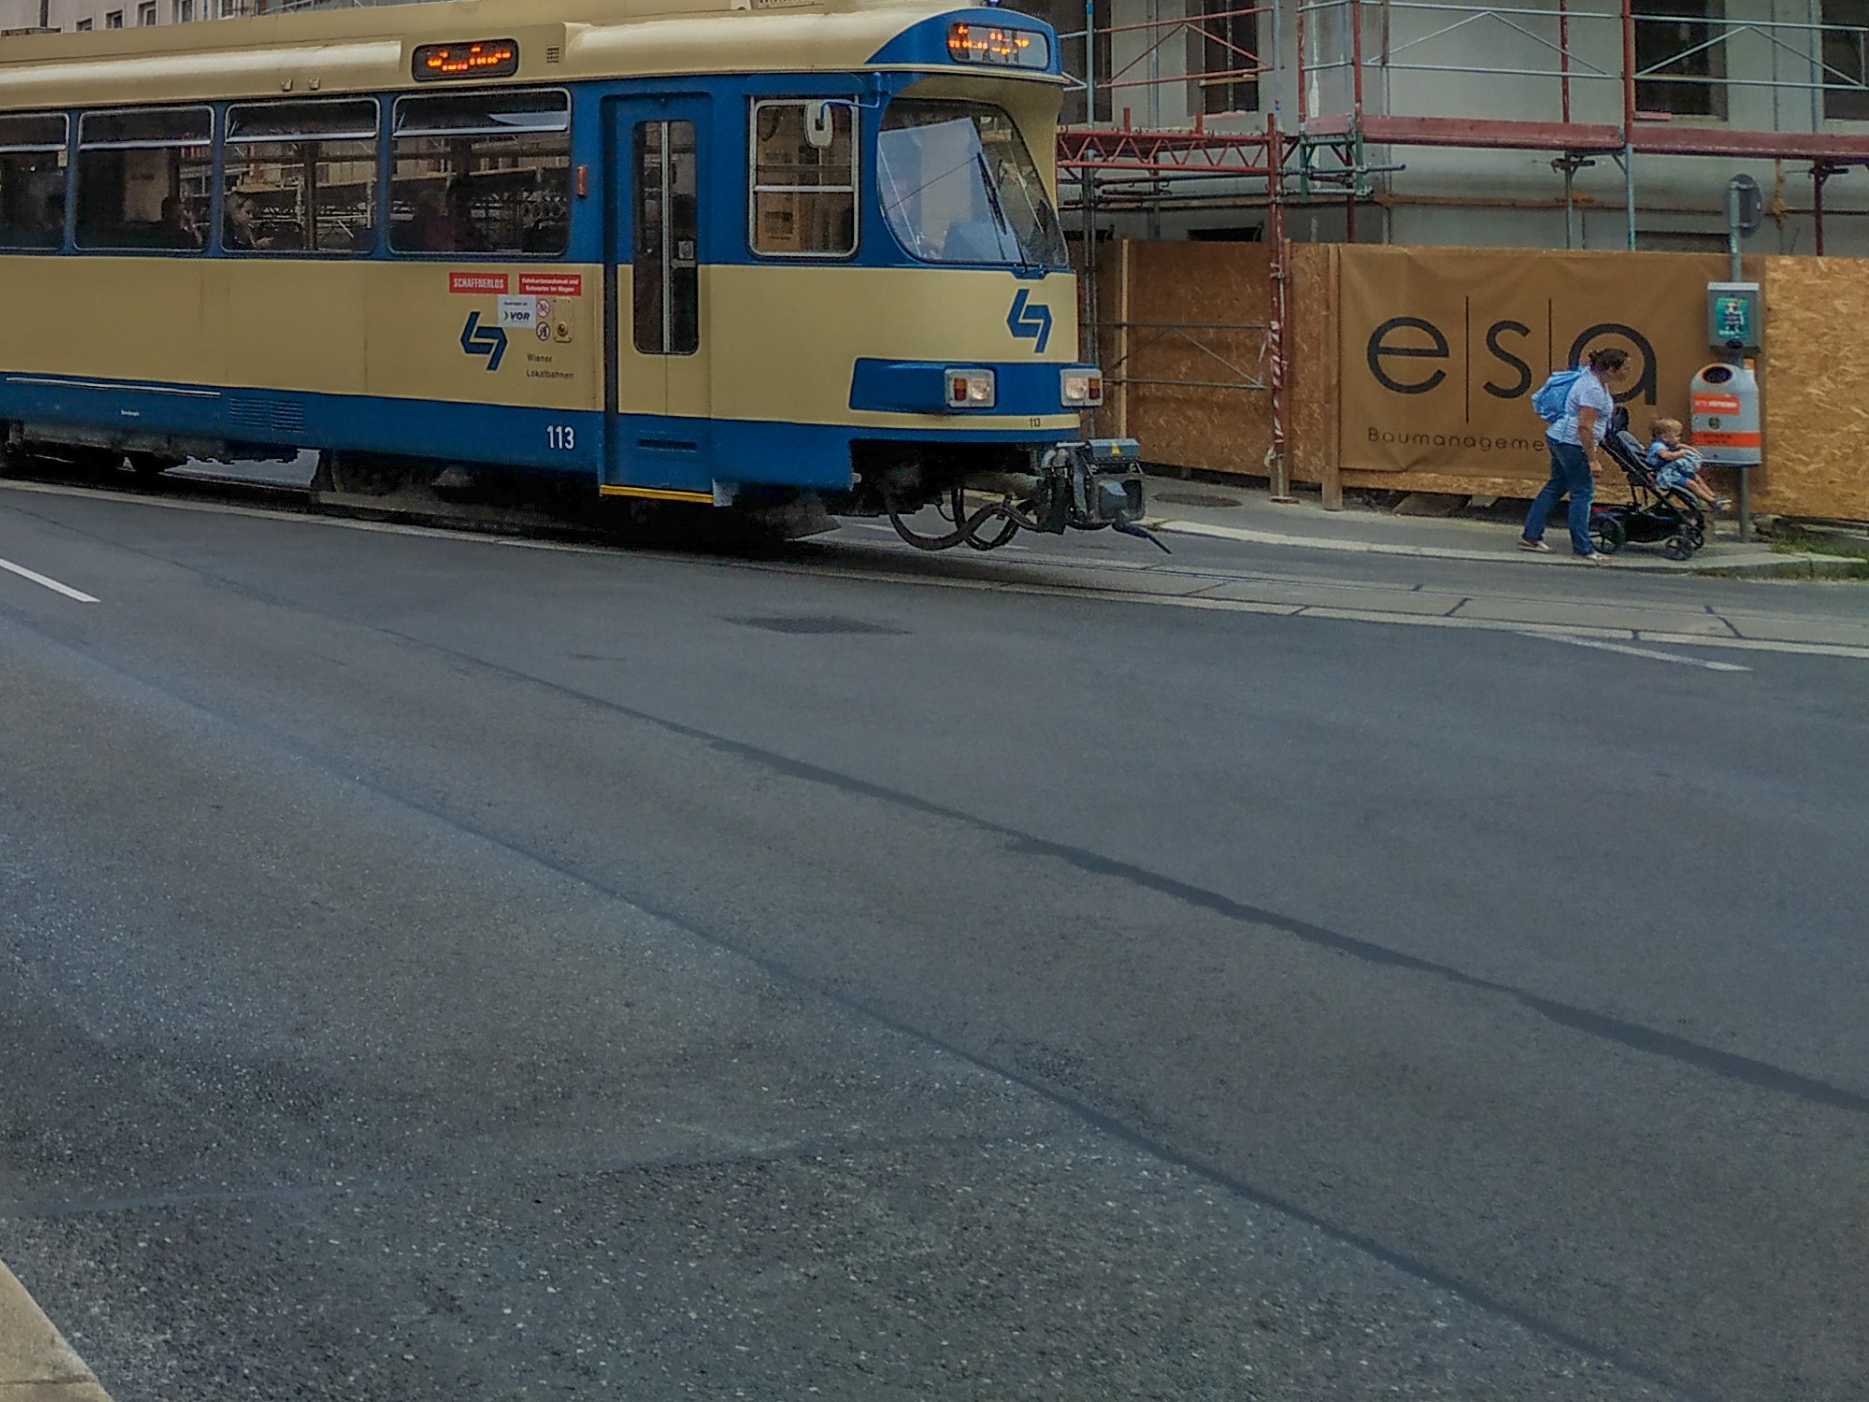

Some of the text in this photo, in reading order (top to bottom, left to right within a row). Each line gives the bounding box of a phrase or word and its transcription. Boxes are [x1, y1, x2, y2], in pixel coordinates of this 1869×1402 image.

[453, 277, 505, 288] SCHAFFNERLOS
[509, 311, 531, 321] VOR
[526, 353, 553, 363] Wiener
[526, 369, 575, 380] Lokalbahnen
[1029, 417, 1041, 428] 113
[546, 425, 575, 449] 113
[1368, 427, 1546, 452] Baumanageme
